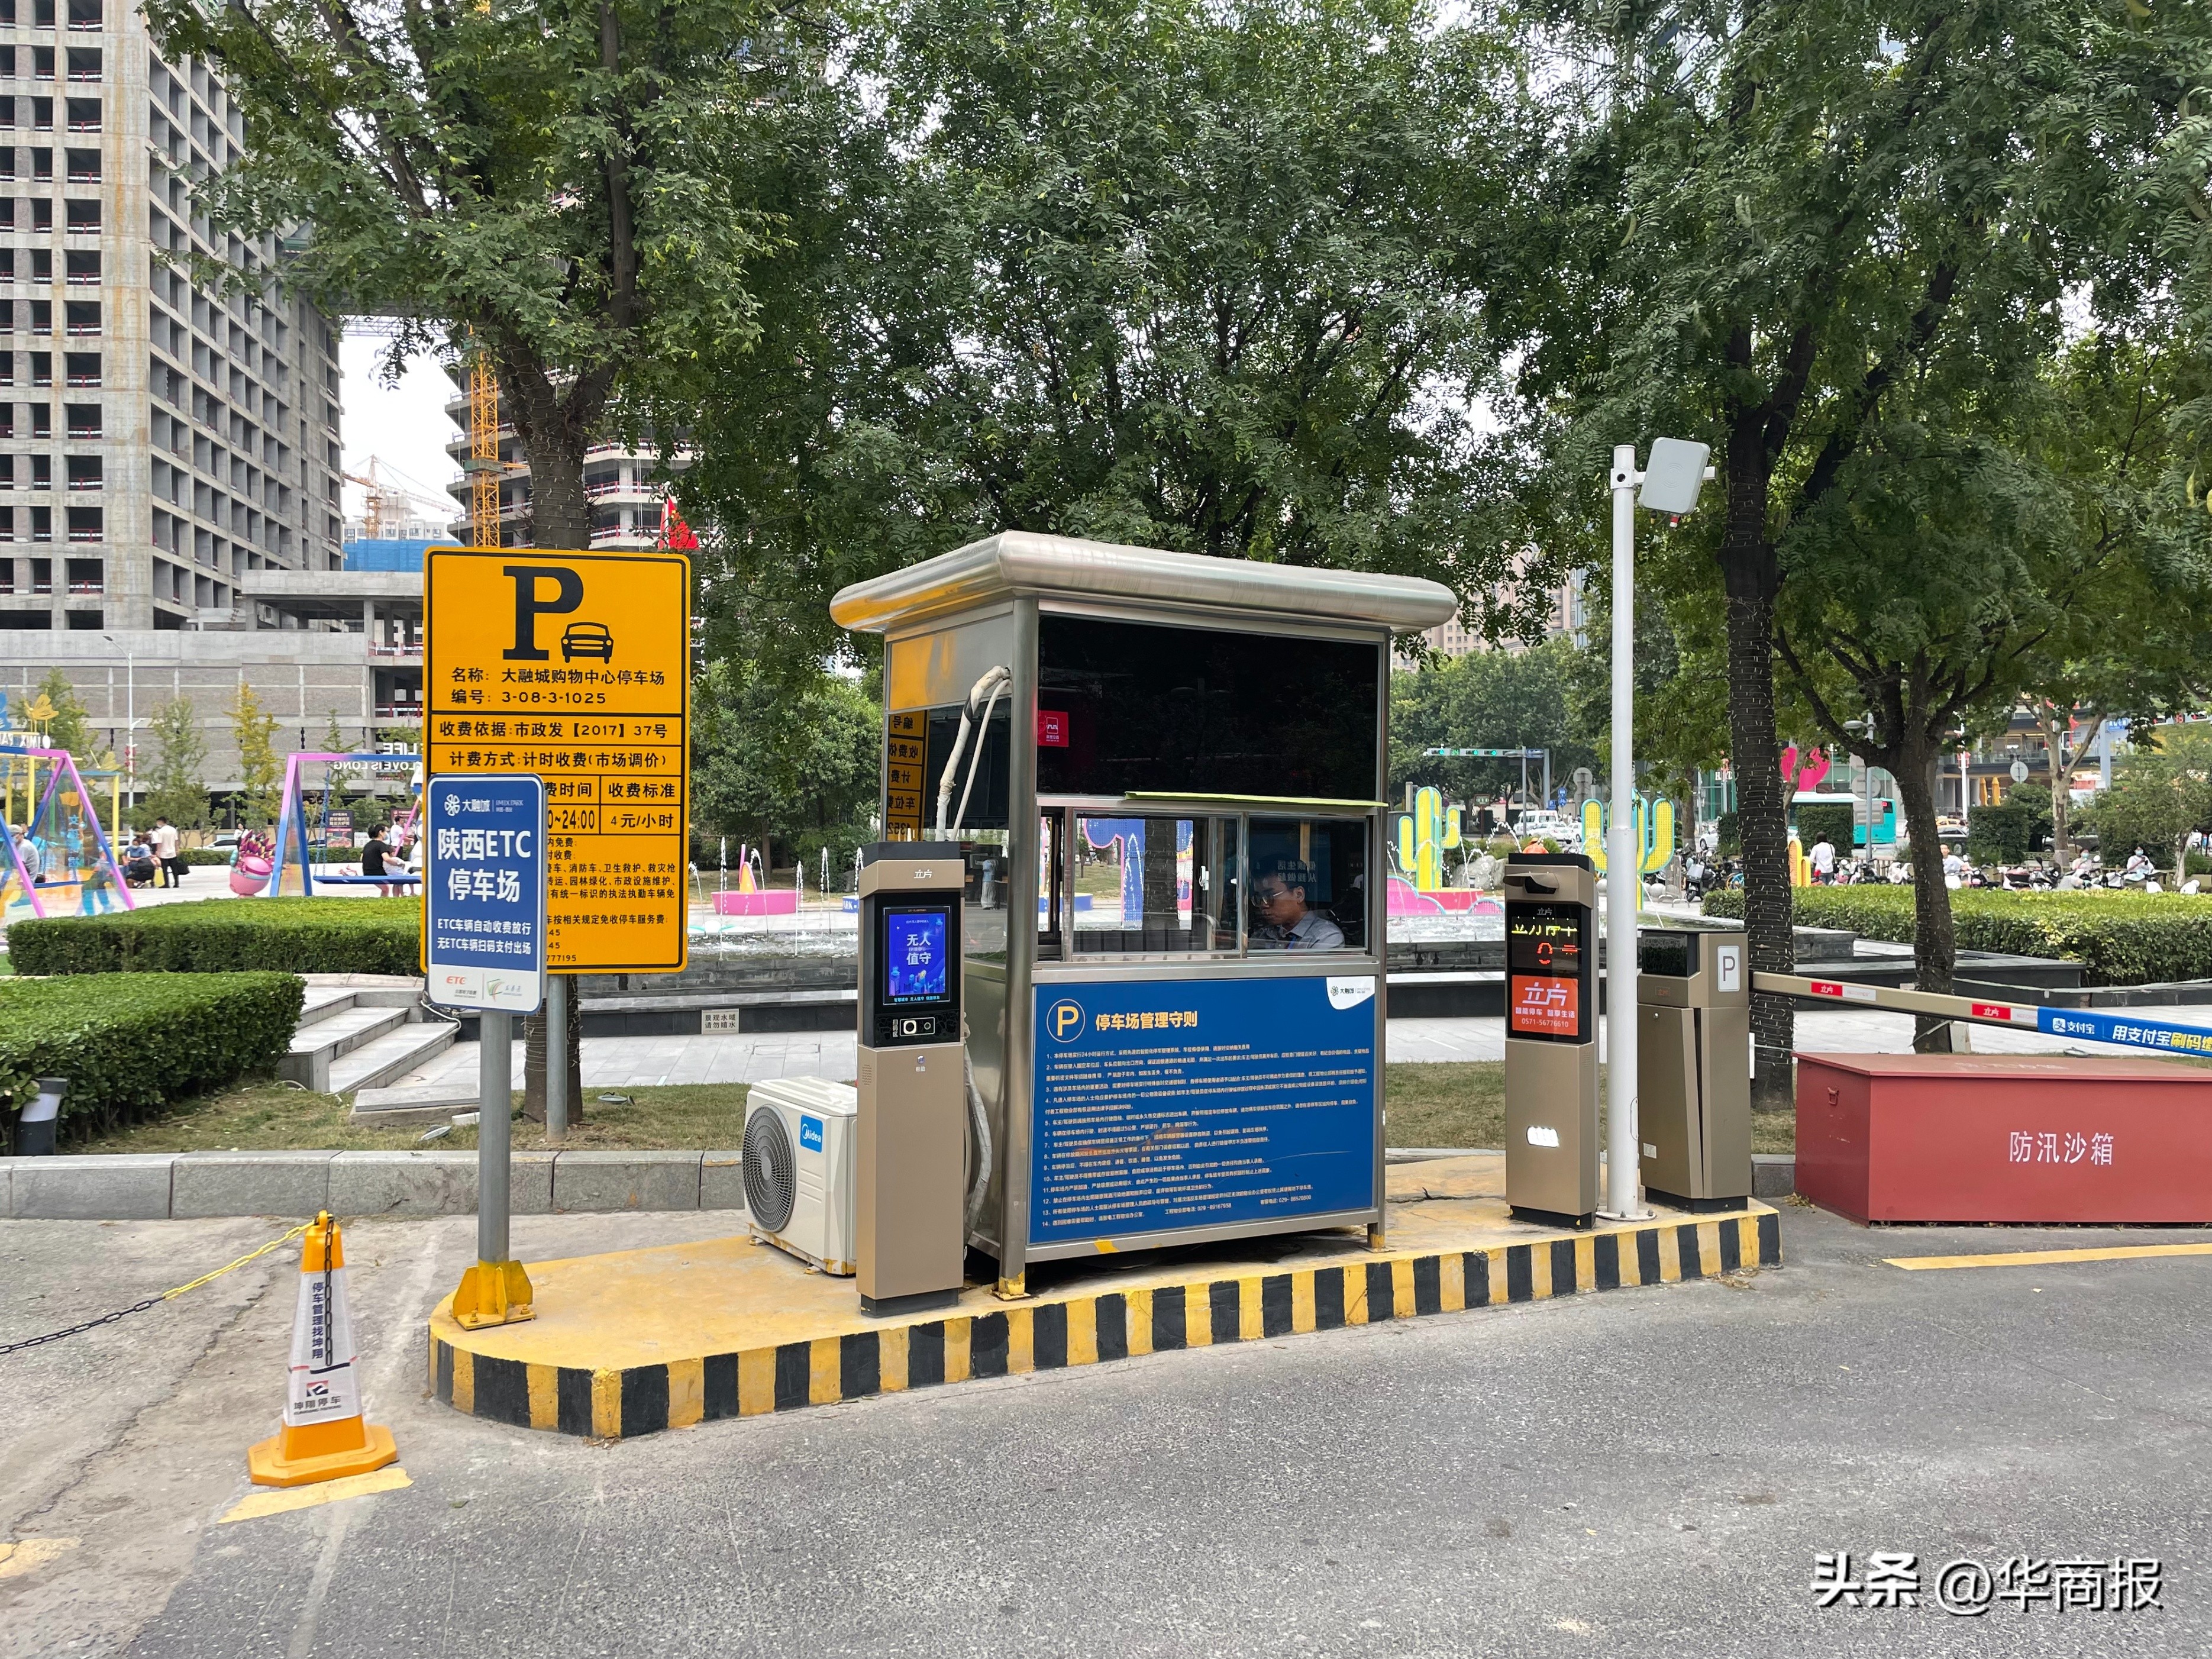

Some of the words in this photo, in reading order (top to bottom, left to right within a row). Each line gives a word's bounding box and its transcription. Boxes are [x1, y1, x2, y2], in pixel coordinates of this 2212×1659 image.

[503, 566, 584, 660] P
[608, 782, 676, 798] 收费标准
[438, 827, 531, 860] 陕西ETC
[448, 868, 521, 903] 停车场
[547, 889, 675, 899] 有统一标识的执法执勤车辆免
[906, 934, 931, 947] 无人
[906, 952, 932, 965] 值守
[1722, 954, 1736, 982] P
[446, 976, 467, 985] ETC
[1522, 982, 1568, 1006] 立方
[1057, 1006, 1080, 1036] P
[1095, 1010, 1198, 1031] 停车场管理守则
[2067, 1021, 2095, 1035] 支付宝
[801, 1123, 822, 1144] Midea
[2009, 1131, 2115, 1167] 防汛沙箱
